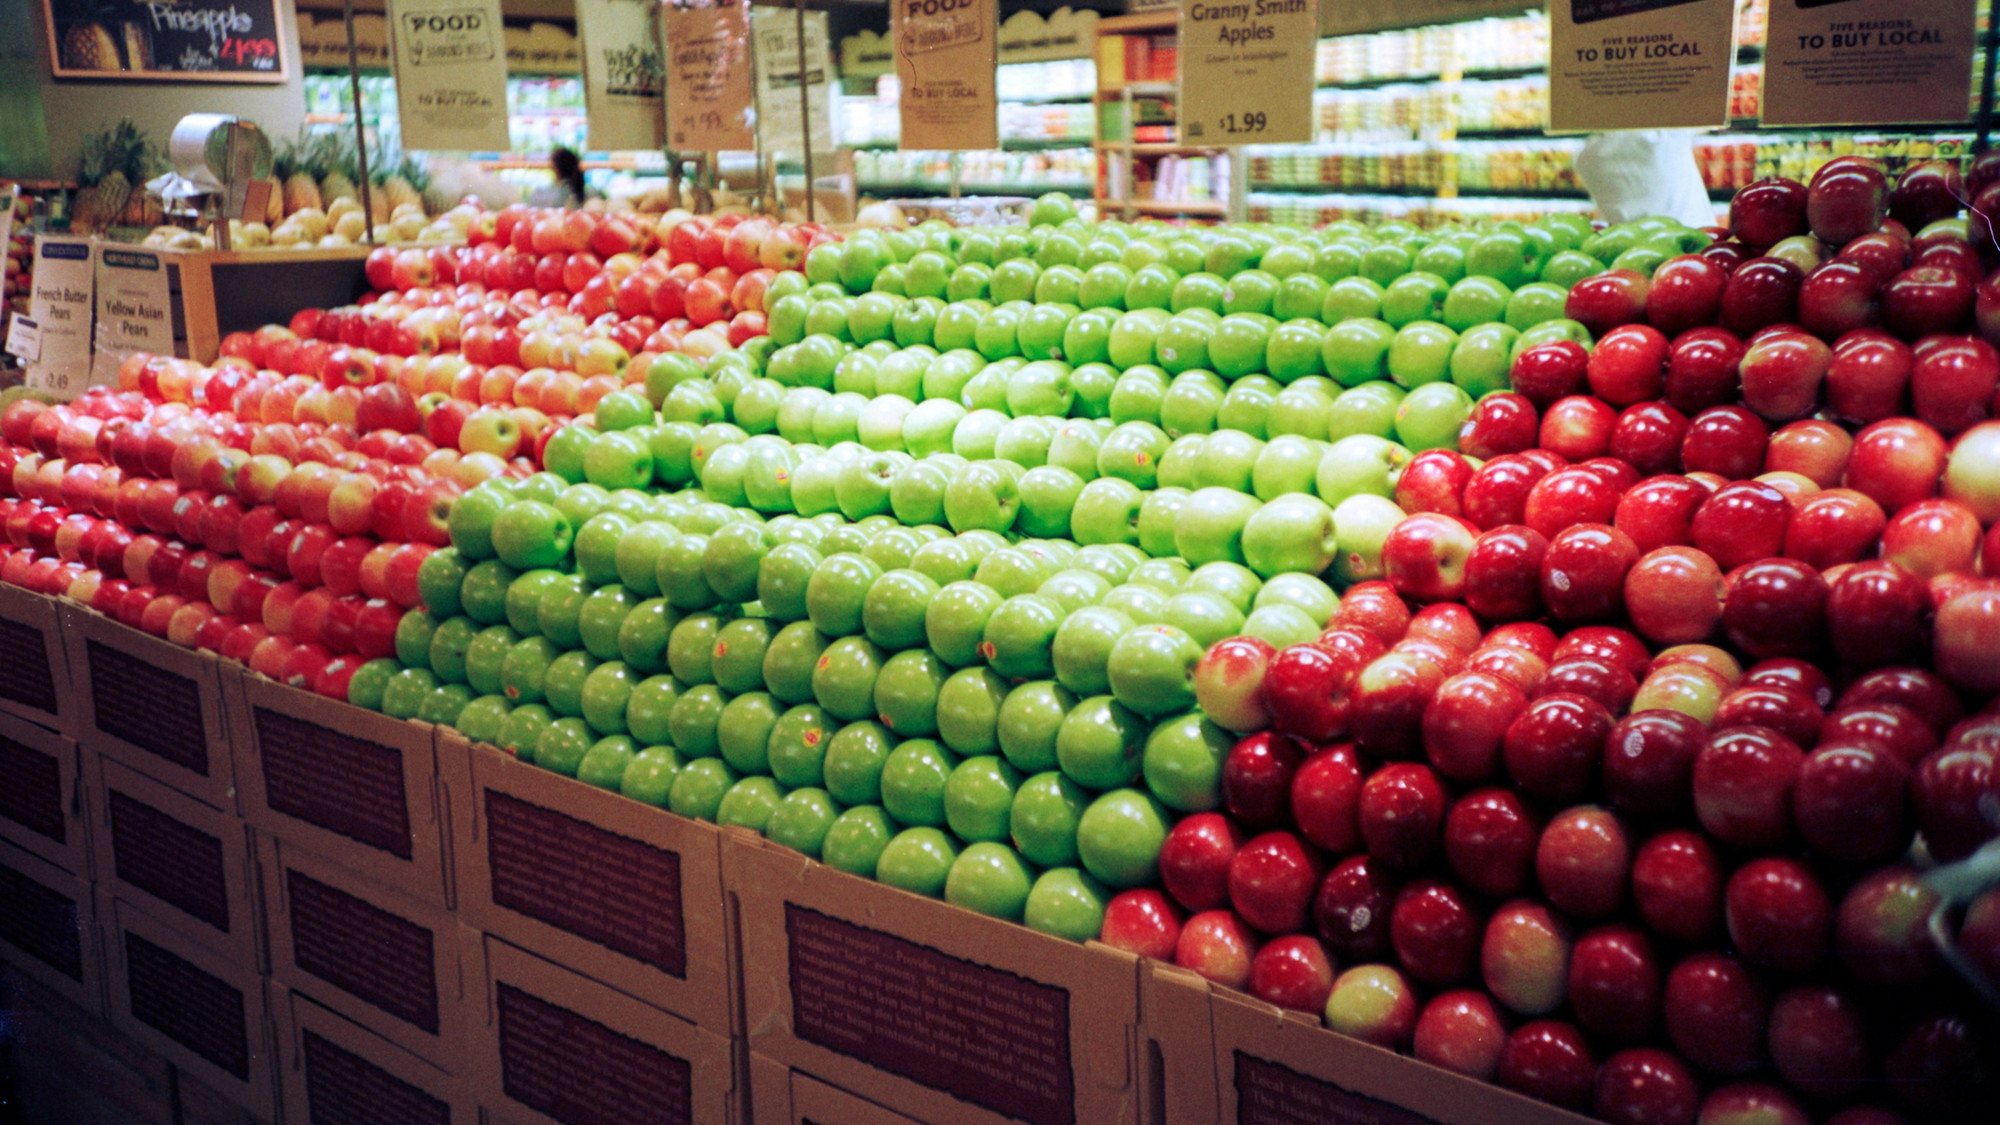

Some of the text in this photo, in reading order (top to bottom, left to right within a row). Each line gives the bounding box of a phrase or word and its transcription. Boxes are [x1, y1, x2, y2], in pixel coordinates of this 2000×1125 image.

[908, 0, 972, 18] FOOD
[1192, 0, 1306, 22] Granny Smith
[148, 3, 253, 42] Pineapple
[410, 15, 481, 33] FOOD
[1830, 19, 1913, 32] FIVE REASONS
[1218, 22, 1275, 46] Apples
[1602, 33, 1674, 45] FIVE REASONS
[1798, 29, 1944, 49] TO BUY LOCAL
[1576, 42, 1702, 62] TO BUY LOCAL
[927, 88, 945, 98] BUY
[948, 88, 978, 98] LOCAL
[1219, 112, 1267, 133] $1.99
[37, 286, 88, 303] French Butter
[50, 305, 71, 320] Pears
[105, 300, 164, 320] Yellow Asian
[122, 319, 149, 338] Pears
